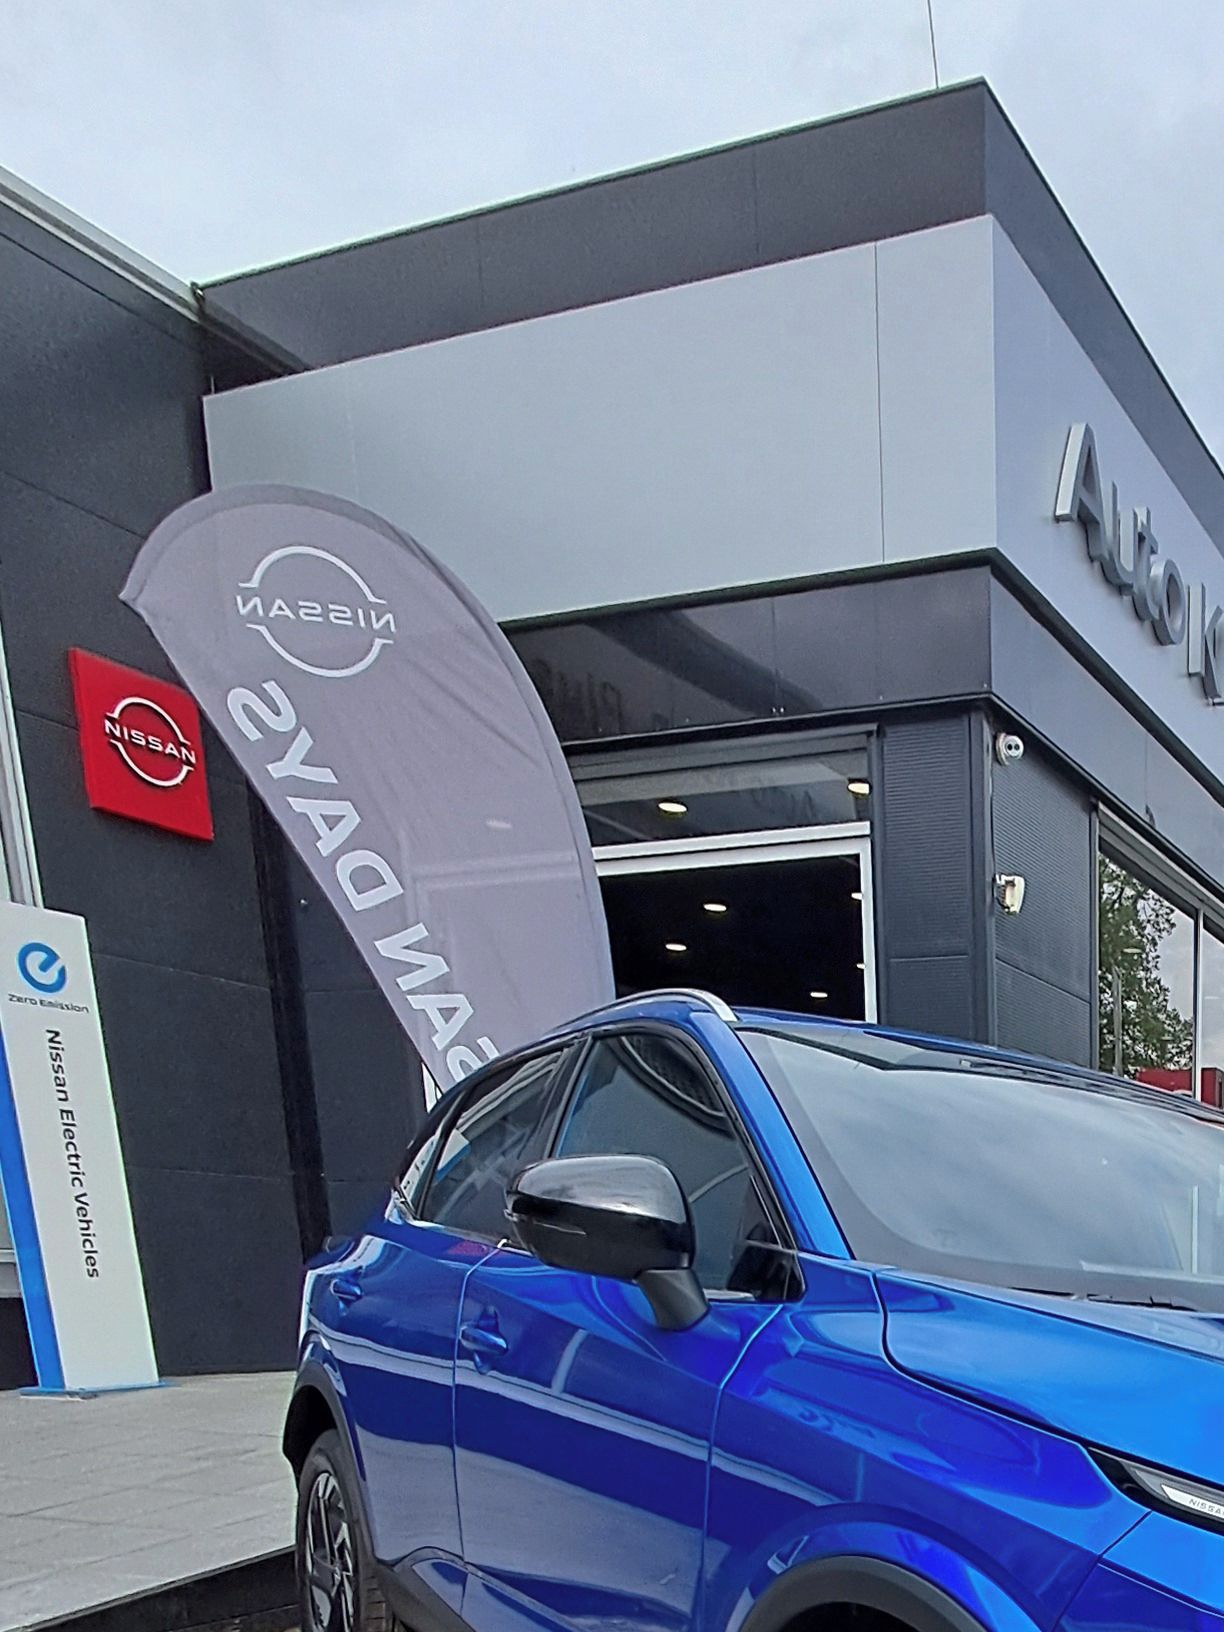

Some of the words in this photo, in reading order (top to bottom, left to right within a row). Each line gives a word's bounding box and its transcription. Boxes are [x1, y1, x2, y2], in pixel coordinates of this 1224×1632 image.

[104, 719, 197, 765] NISSAN
[8, 993, 37, 1006] Zero
[39, 998, 89, 1014] Emission
[45, 1029, 69, 1102] Nissan
[59, 1108, 84, 1188] Electric
[73, 1192, 100, 1279] Vehicles
